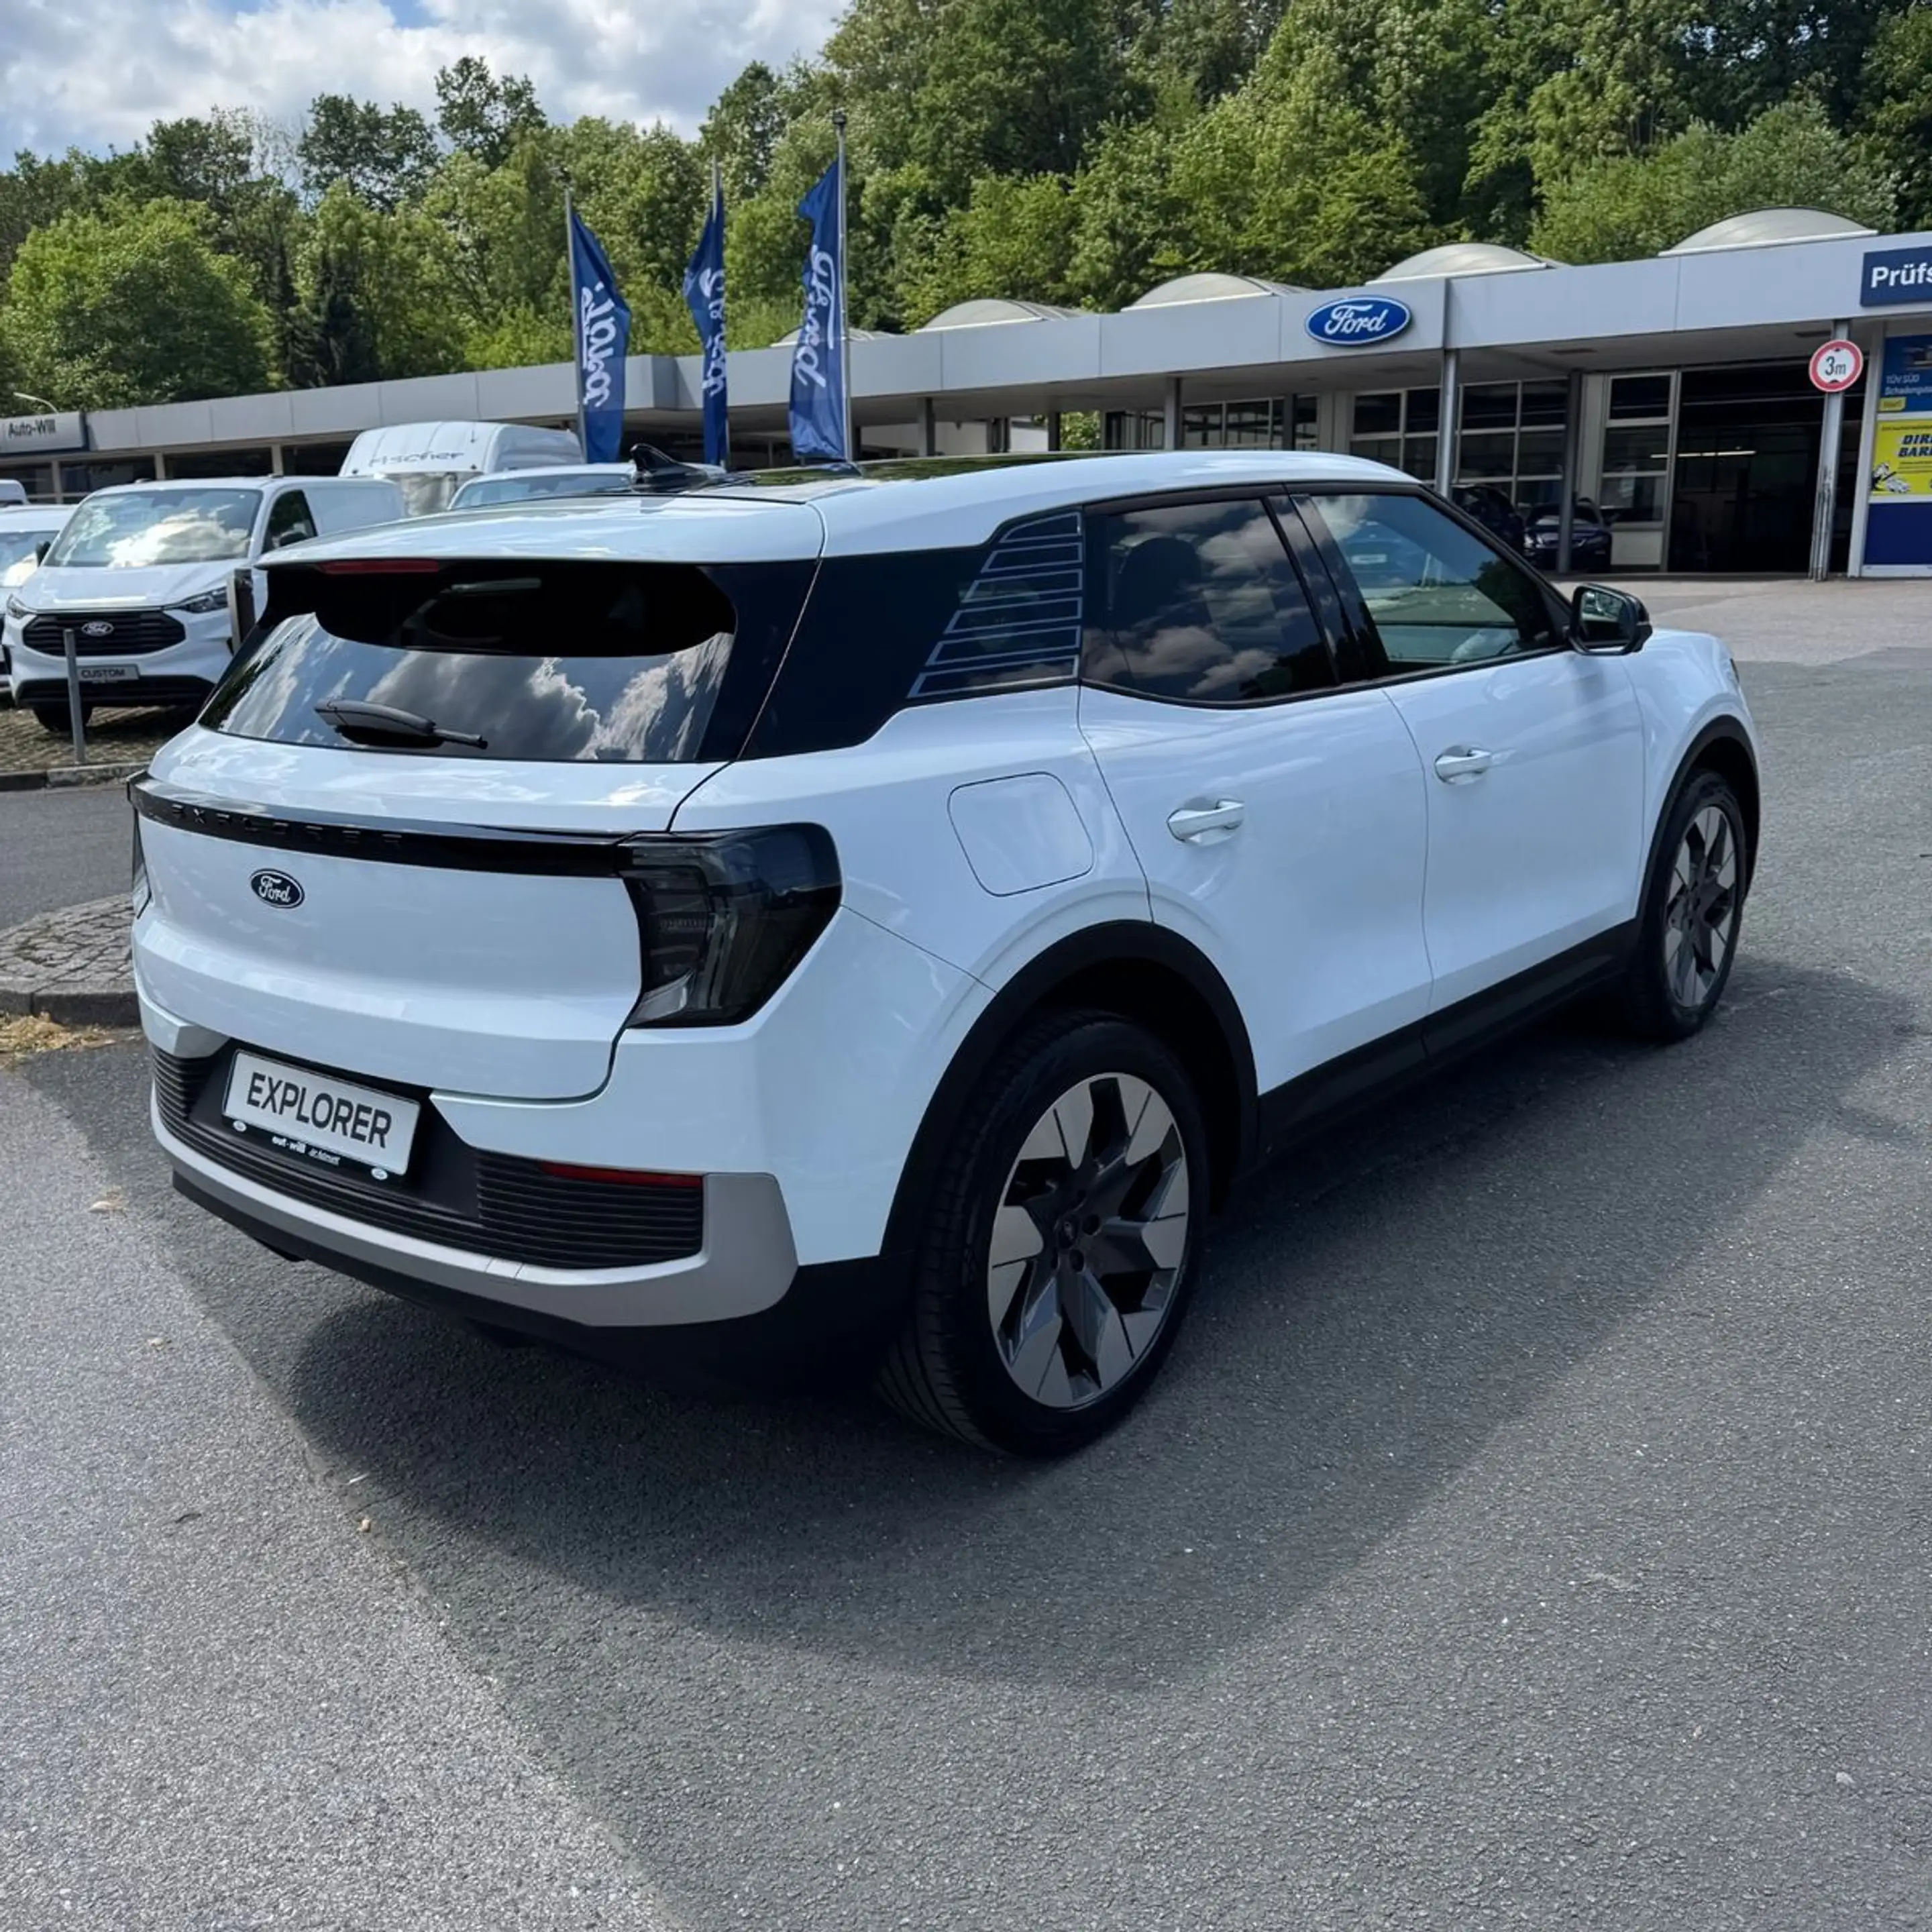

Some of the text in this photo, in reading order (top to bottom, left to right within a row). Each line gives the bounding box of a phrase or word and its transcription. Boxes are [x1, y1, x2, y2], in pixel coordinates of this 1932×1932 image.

[1870, 262, 1932, 288] Prüfs
[795, 244, 835, 388] Ford
[1324, 304, 1389, 335] Ford
[1902, 433, 1932, 445] DIR
[80, 669, 126, 679] CUSTOM
[258, 875, 292, 903] Ford
[246, 1071, 392, 1149] EXPLORER
